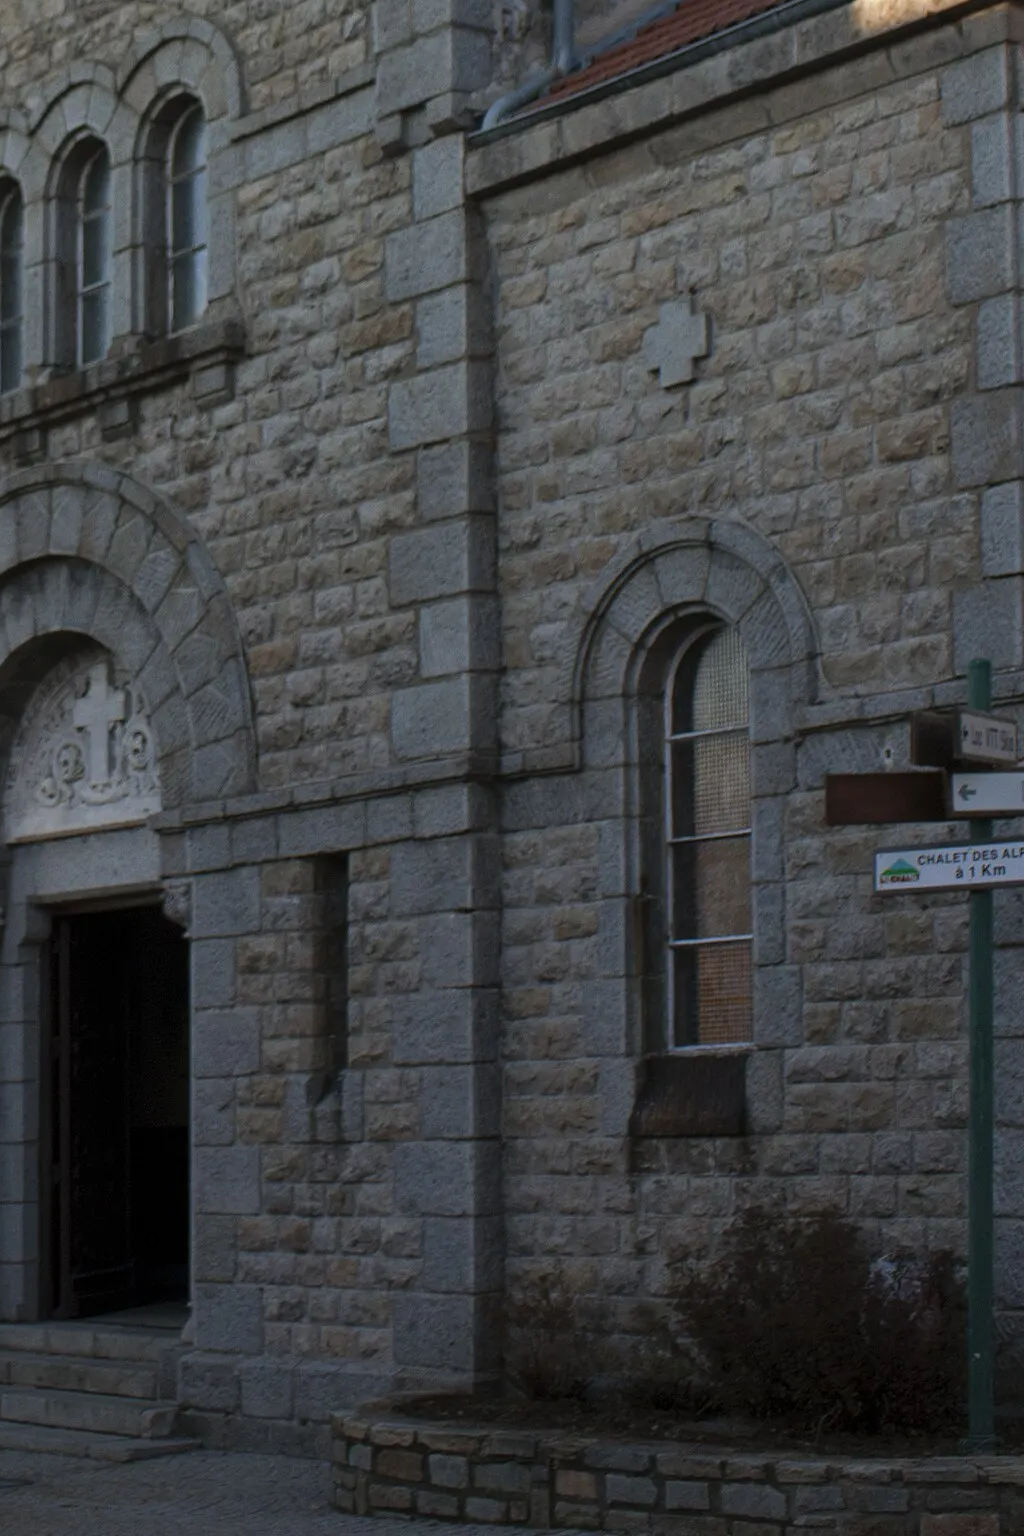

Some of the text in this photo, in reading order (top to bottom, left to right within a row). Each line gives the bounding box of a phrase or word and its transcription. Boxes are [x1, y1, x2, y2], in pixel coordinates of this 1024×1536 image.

[917, 851, 969, 866] CHALET
[972, 848, 998, 861] DES
[968, 865, 975, 878] 1
[981, 863, 1006, 877] Km
